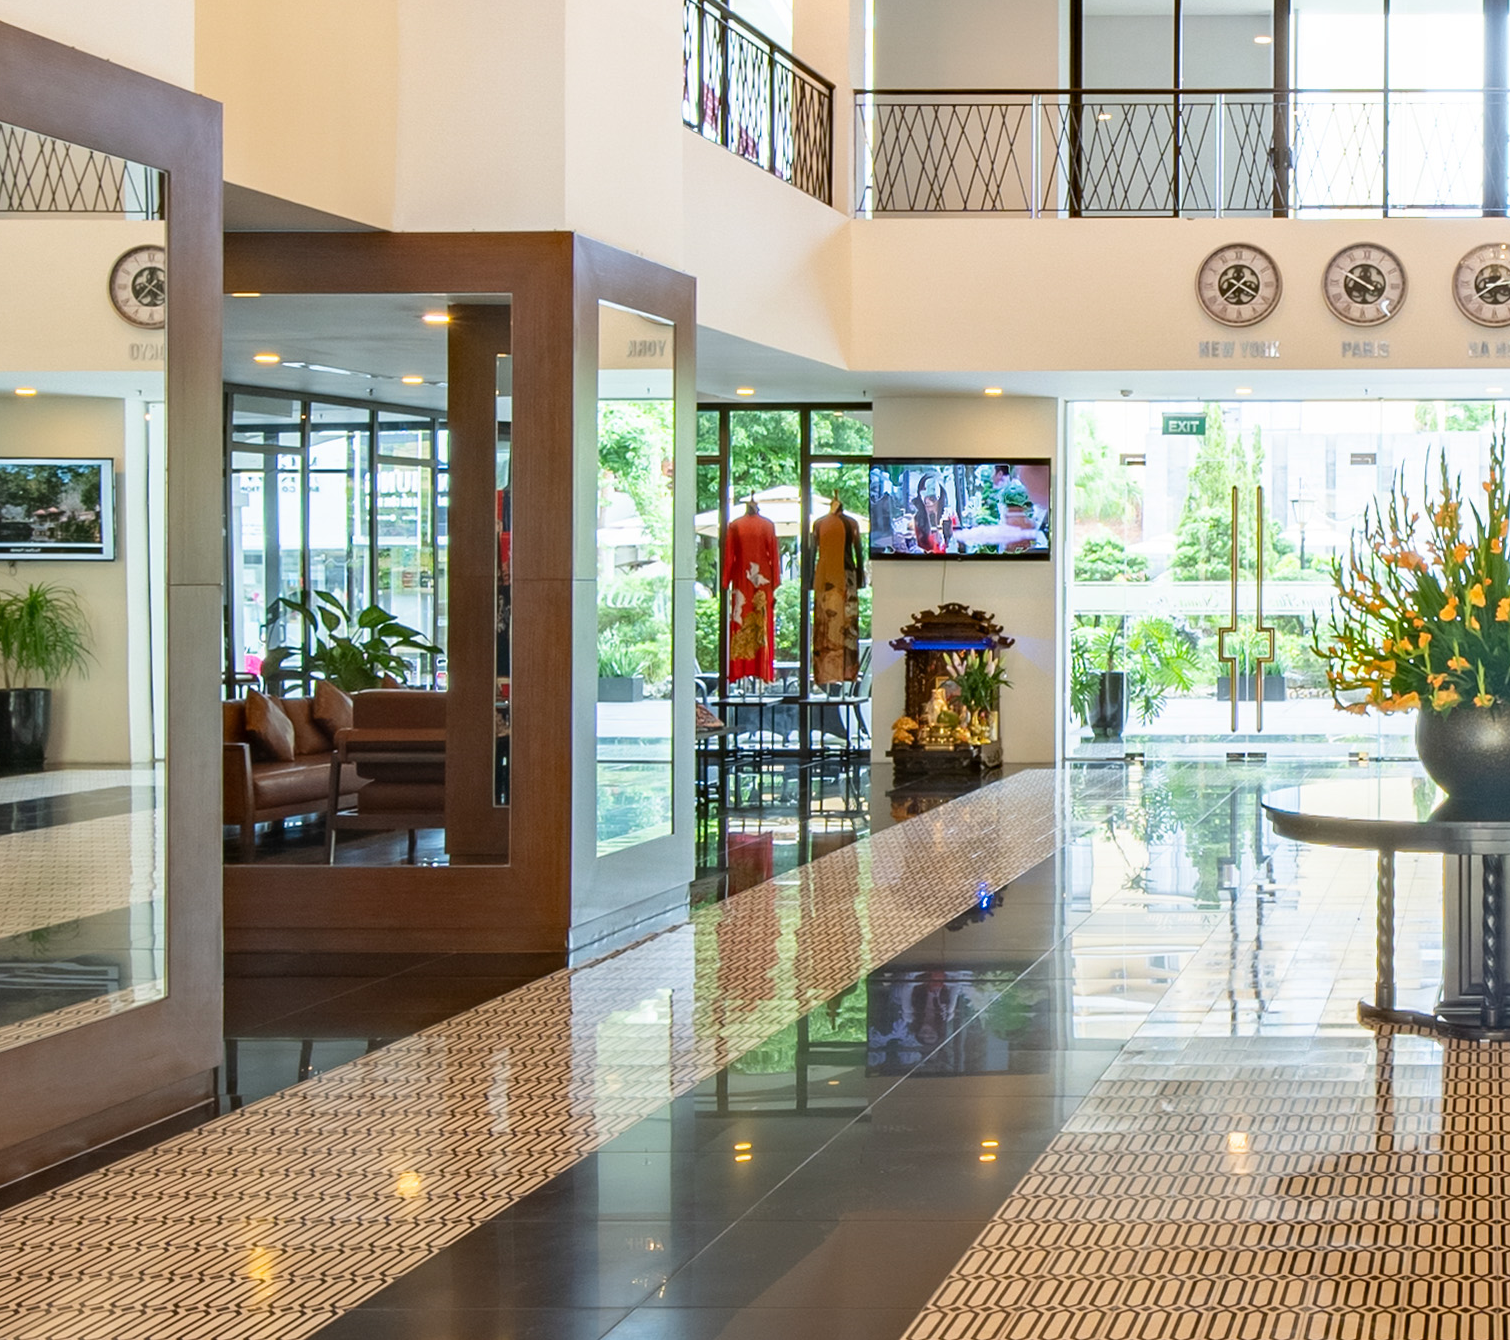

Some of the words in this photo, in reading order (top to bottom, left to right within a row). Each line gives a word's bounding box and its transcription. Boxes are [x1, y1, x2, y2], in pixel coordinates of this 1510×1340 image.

[1199, 341, 1235, 358] NEW
[1241, 341, 1280, 358] YORK
[1341, 341, 1390, 358] PARIS
[1168, 421, 1199, 432] EXIT
